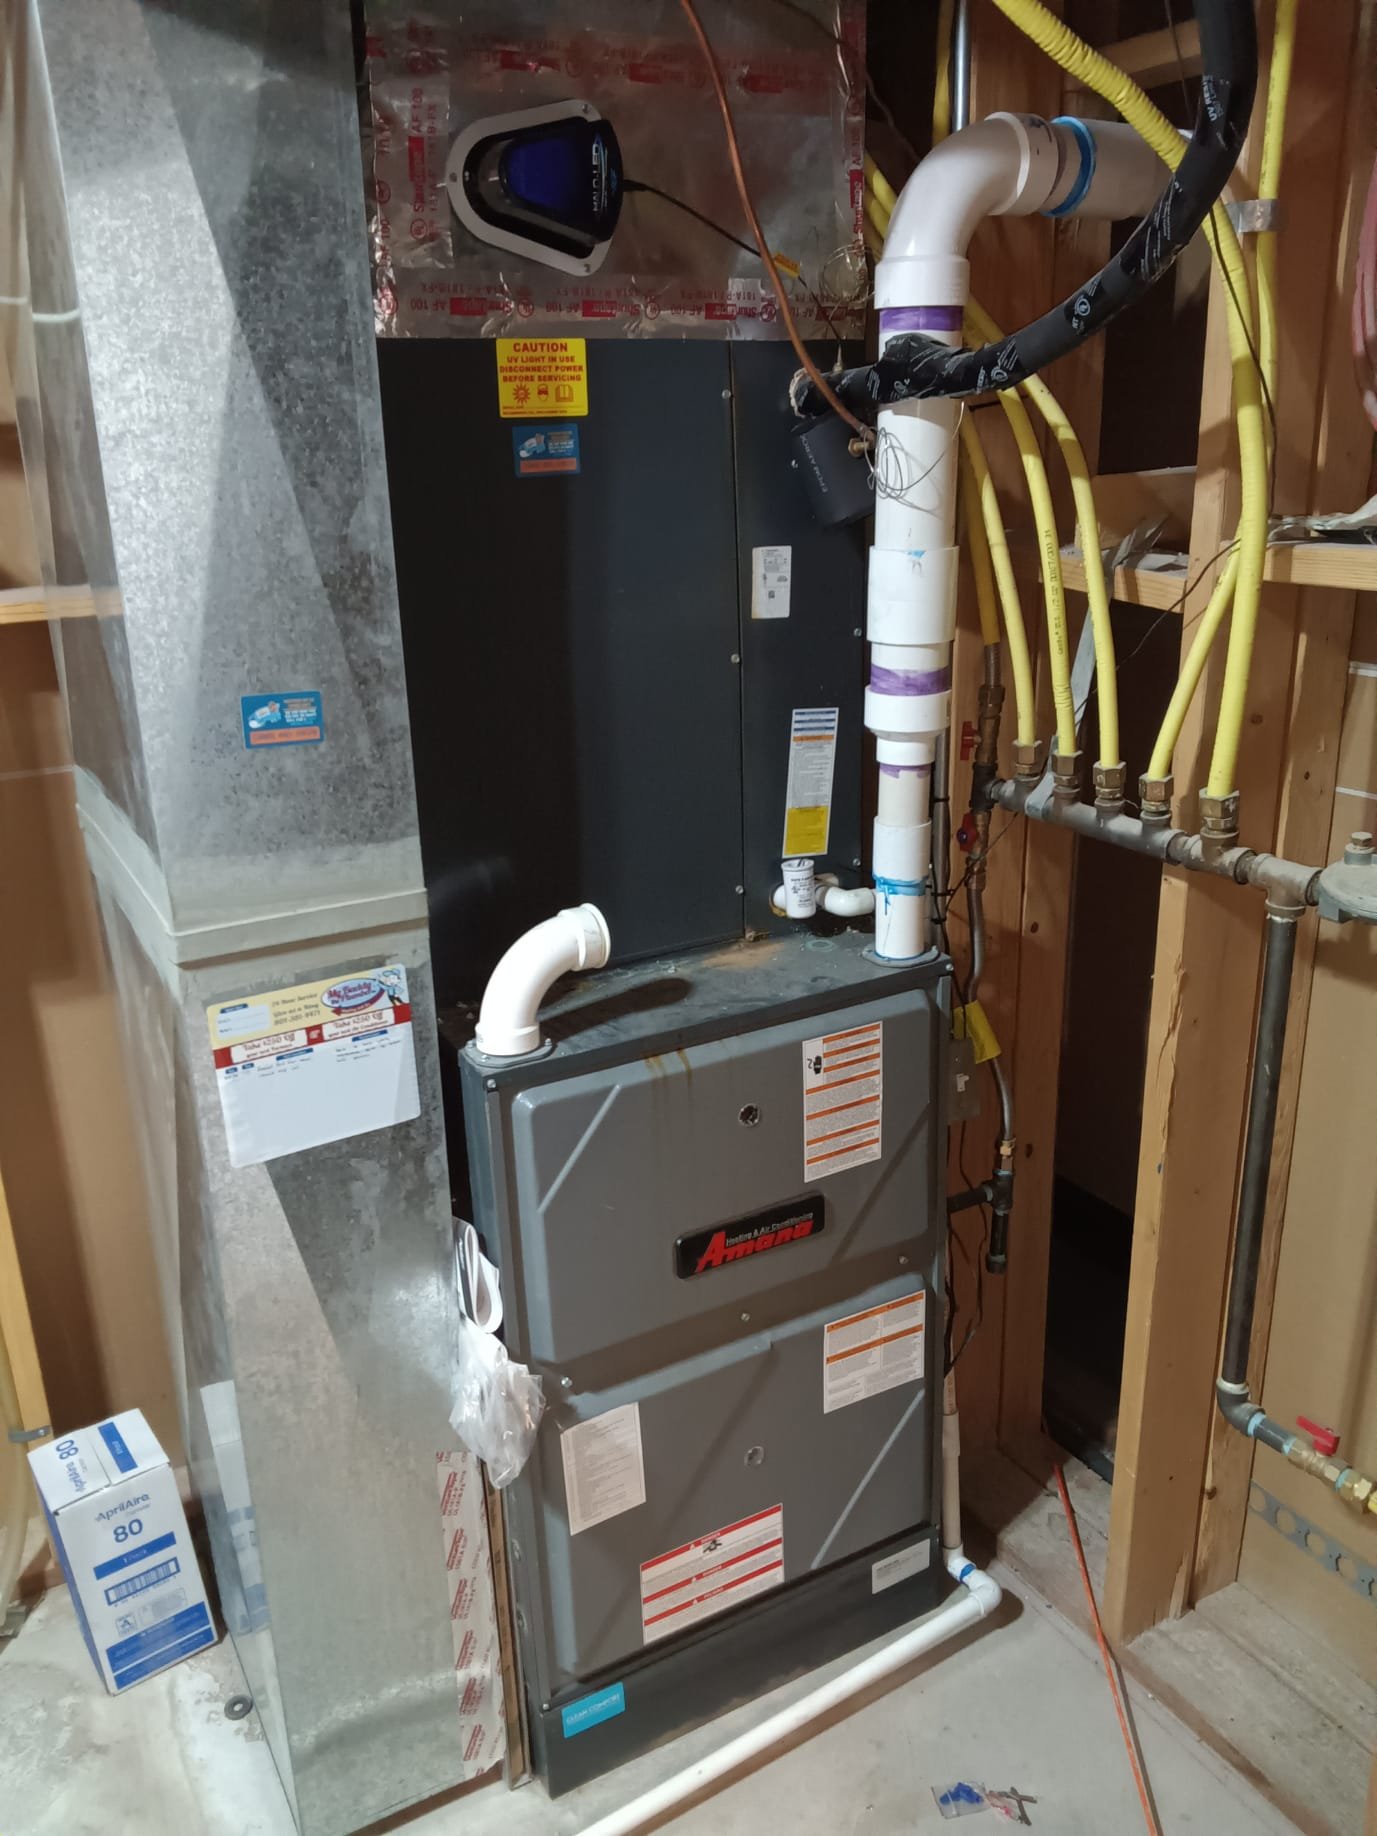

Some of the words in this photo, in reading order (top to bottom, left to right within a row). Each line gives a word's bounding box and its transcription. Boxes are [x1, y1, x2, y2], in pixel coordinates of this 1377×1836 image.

[513, 342, 568, 353] CAUTION
[500, 365, 552, 373] DISCONNECT
[502, 374, 534, 383] BEFORE
[537, 374, 582, 383] SERVICING
[694, 1219, 815, 1274] Amana
[55, 1438, 80, 1462] 80
[97, 1493, 150, 1521] AprilAire
[112, 1517, 144, 1544] 80
